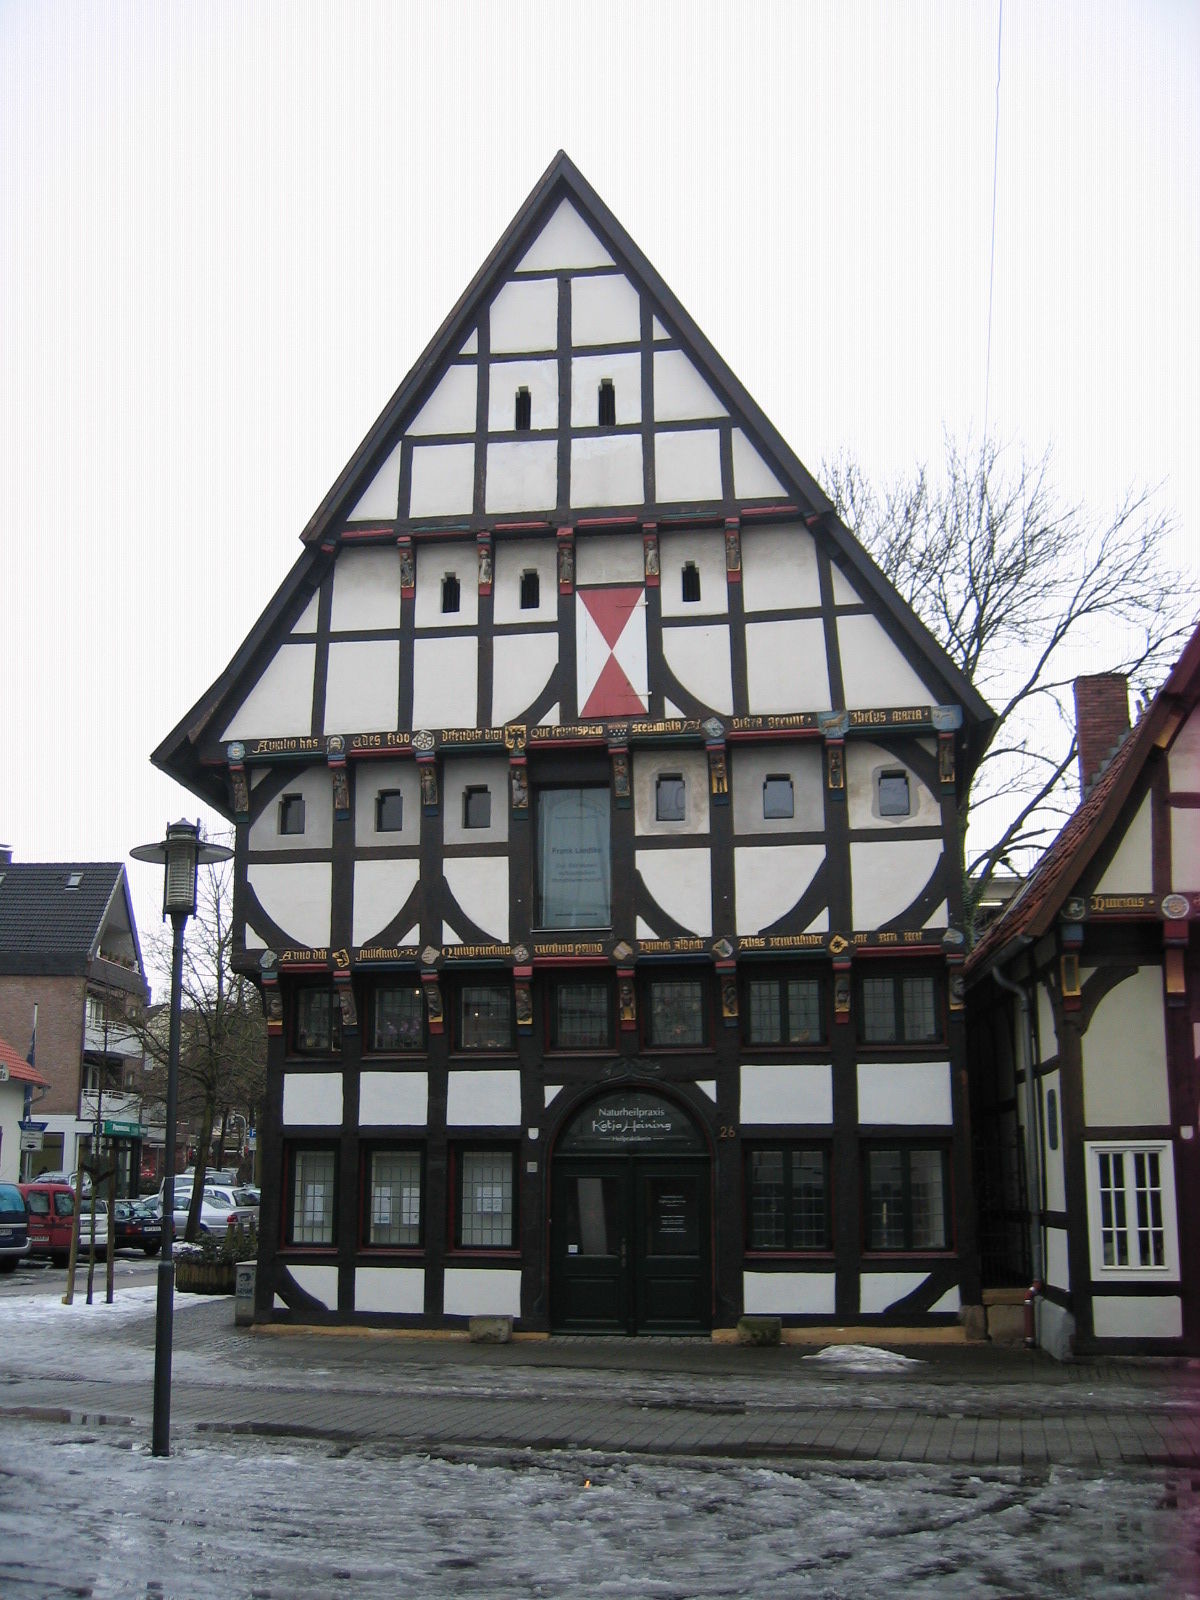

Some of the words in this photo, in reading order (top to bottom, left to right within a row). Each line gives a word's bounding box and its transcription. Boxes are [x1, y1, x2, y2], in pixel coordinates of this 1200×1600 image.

[598, 1107, 665, 1119] Naturheilpraxis
[592, 1119, 622, 1133] Katja
[621, 1119, 672, 1133] Heining
[719, 1125, 737, 1138] 26
